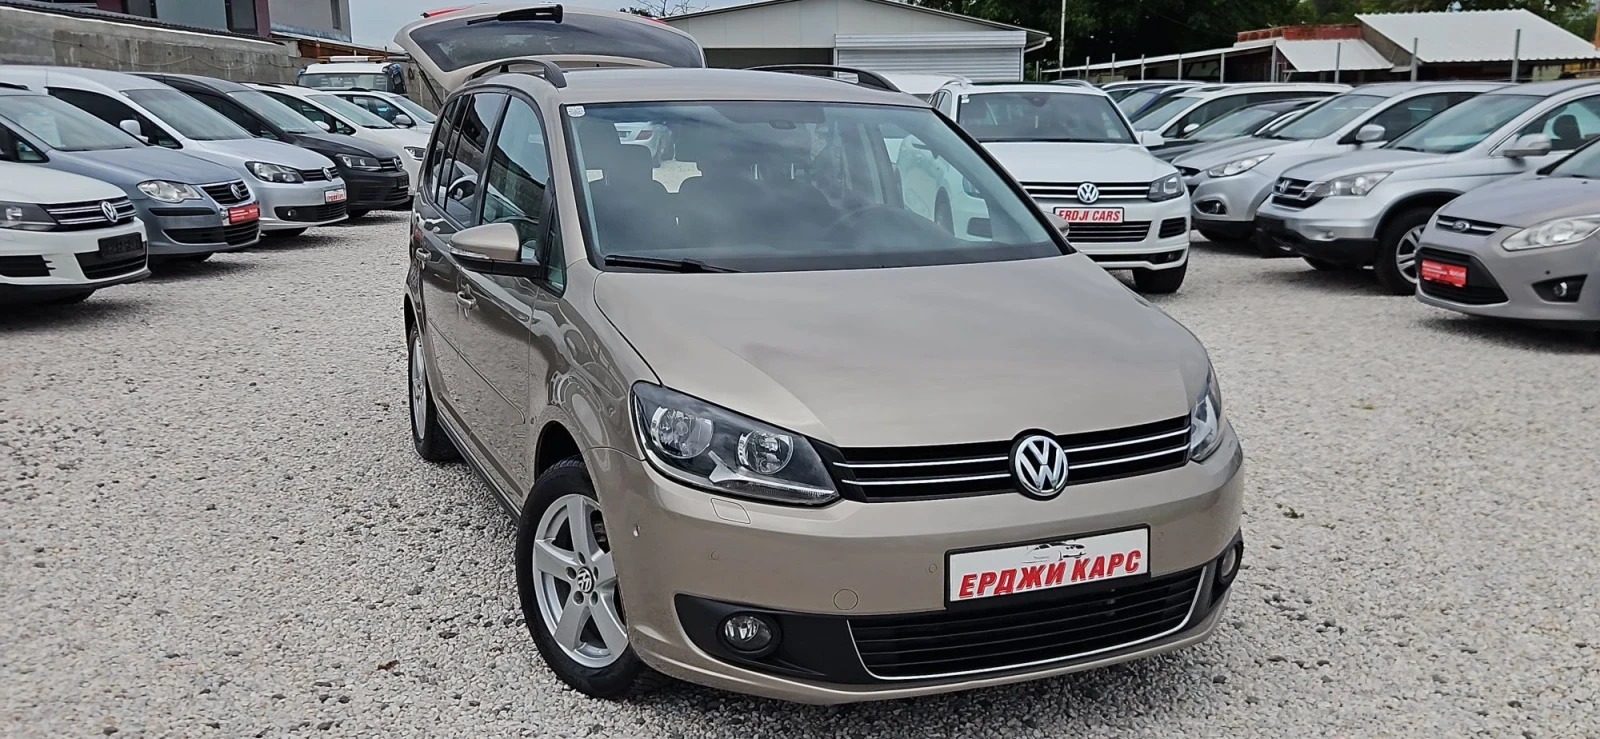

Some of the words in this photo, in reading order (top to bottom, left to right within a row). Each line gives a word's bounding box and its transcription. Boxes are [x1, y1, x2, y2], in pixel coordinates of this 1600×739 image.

[1092, 210, 1121, 221] CARS
[1015, 435, 1068, 496] VW
[958, 561, 1067, 599] ЕРДЖИ
[1071, 549, 1142, 583] КАРС
